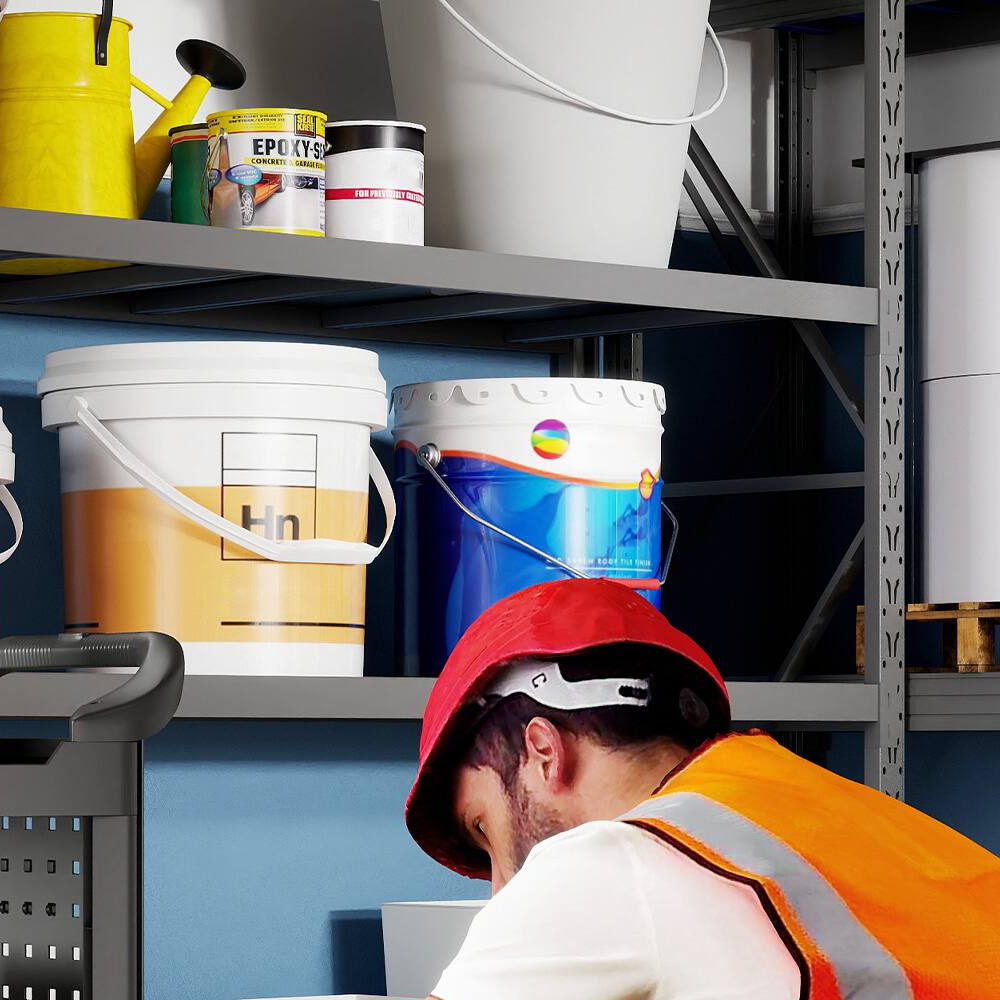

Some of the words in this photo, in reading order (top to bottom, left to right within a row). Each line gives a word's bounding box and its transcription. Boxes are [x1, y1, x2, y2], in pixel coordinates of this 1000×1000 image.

[296, 113, 314, 124] SEAL
[251, 158, 286, 166] CONCRETE
[354, 189, 369, 198] FOR
[241, 503, 300, 541] Hn
